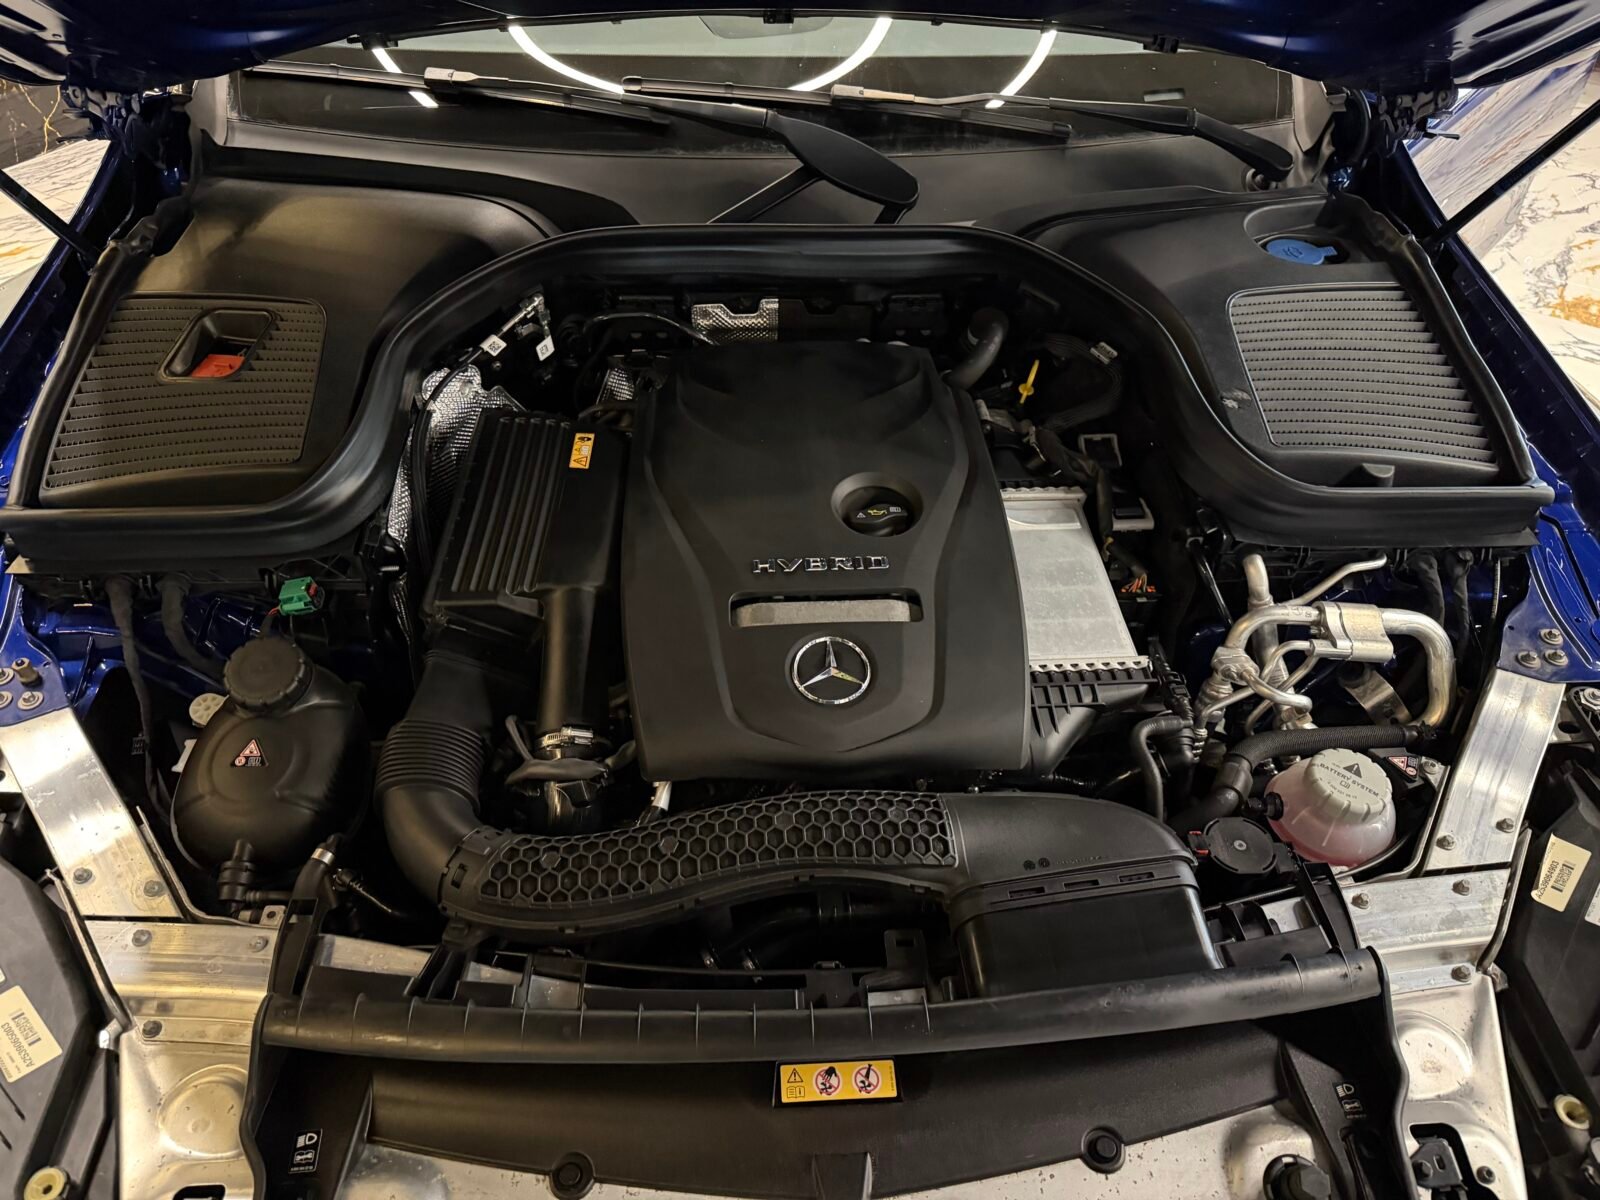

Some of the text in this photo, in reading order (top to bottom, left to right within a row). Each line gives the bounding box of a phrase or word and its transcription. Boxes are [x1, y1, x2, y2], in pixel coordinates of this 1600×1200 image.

[752, 555, 890, 573] HYBRID
[1320, 763, 1352, 780] BATTERY
[1351, 779, 1379, 797] SYSTEM
